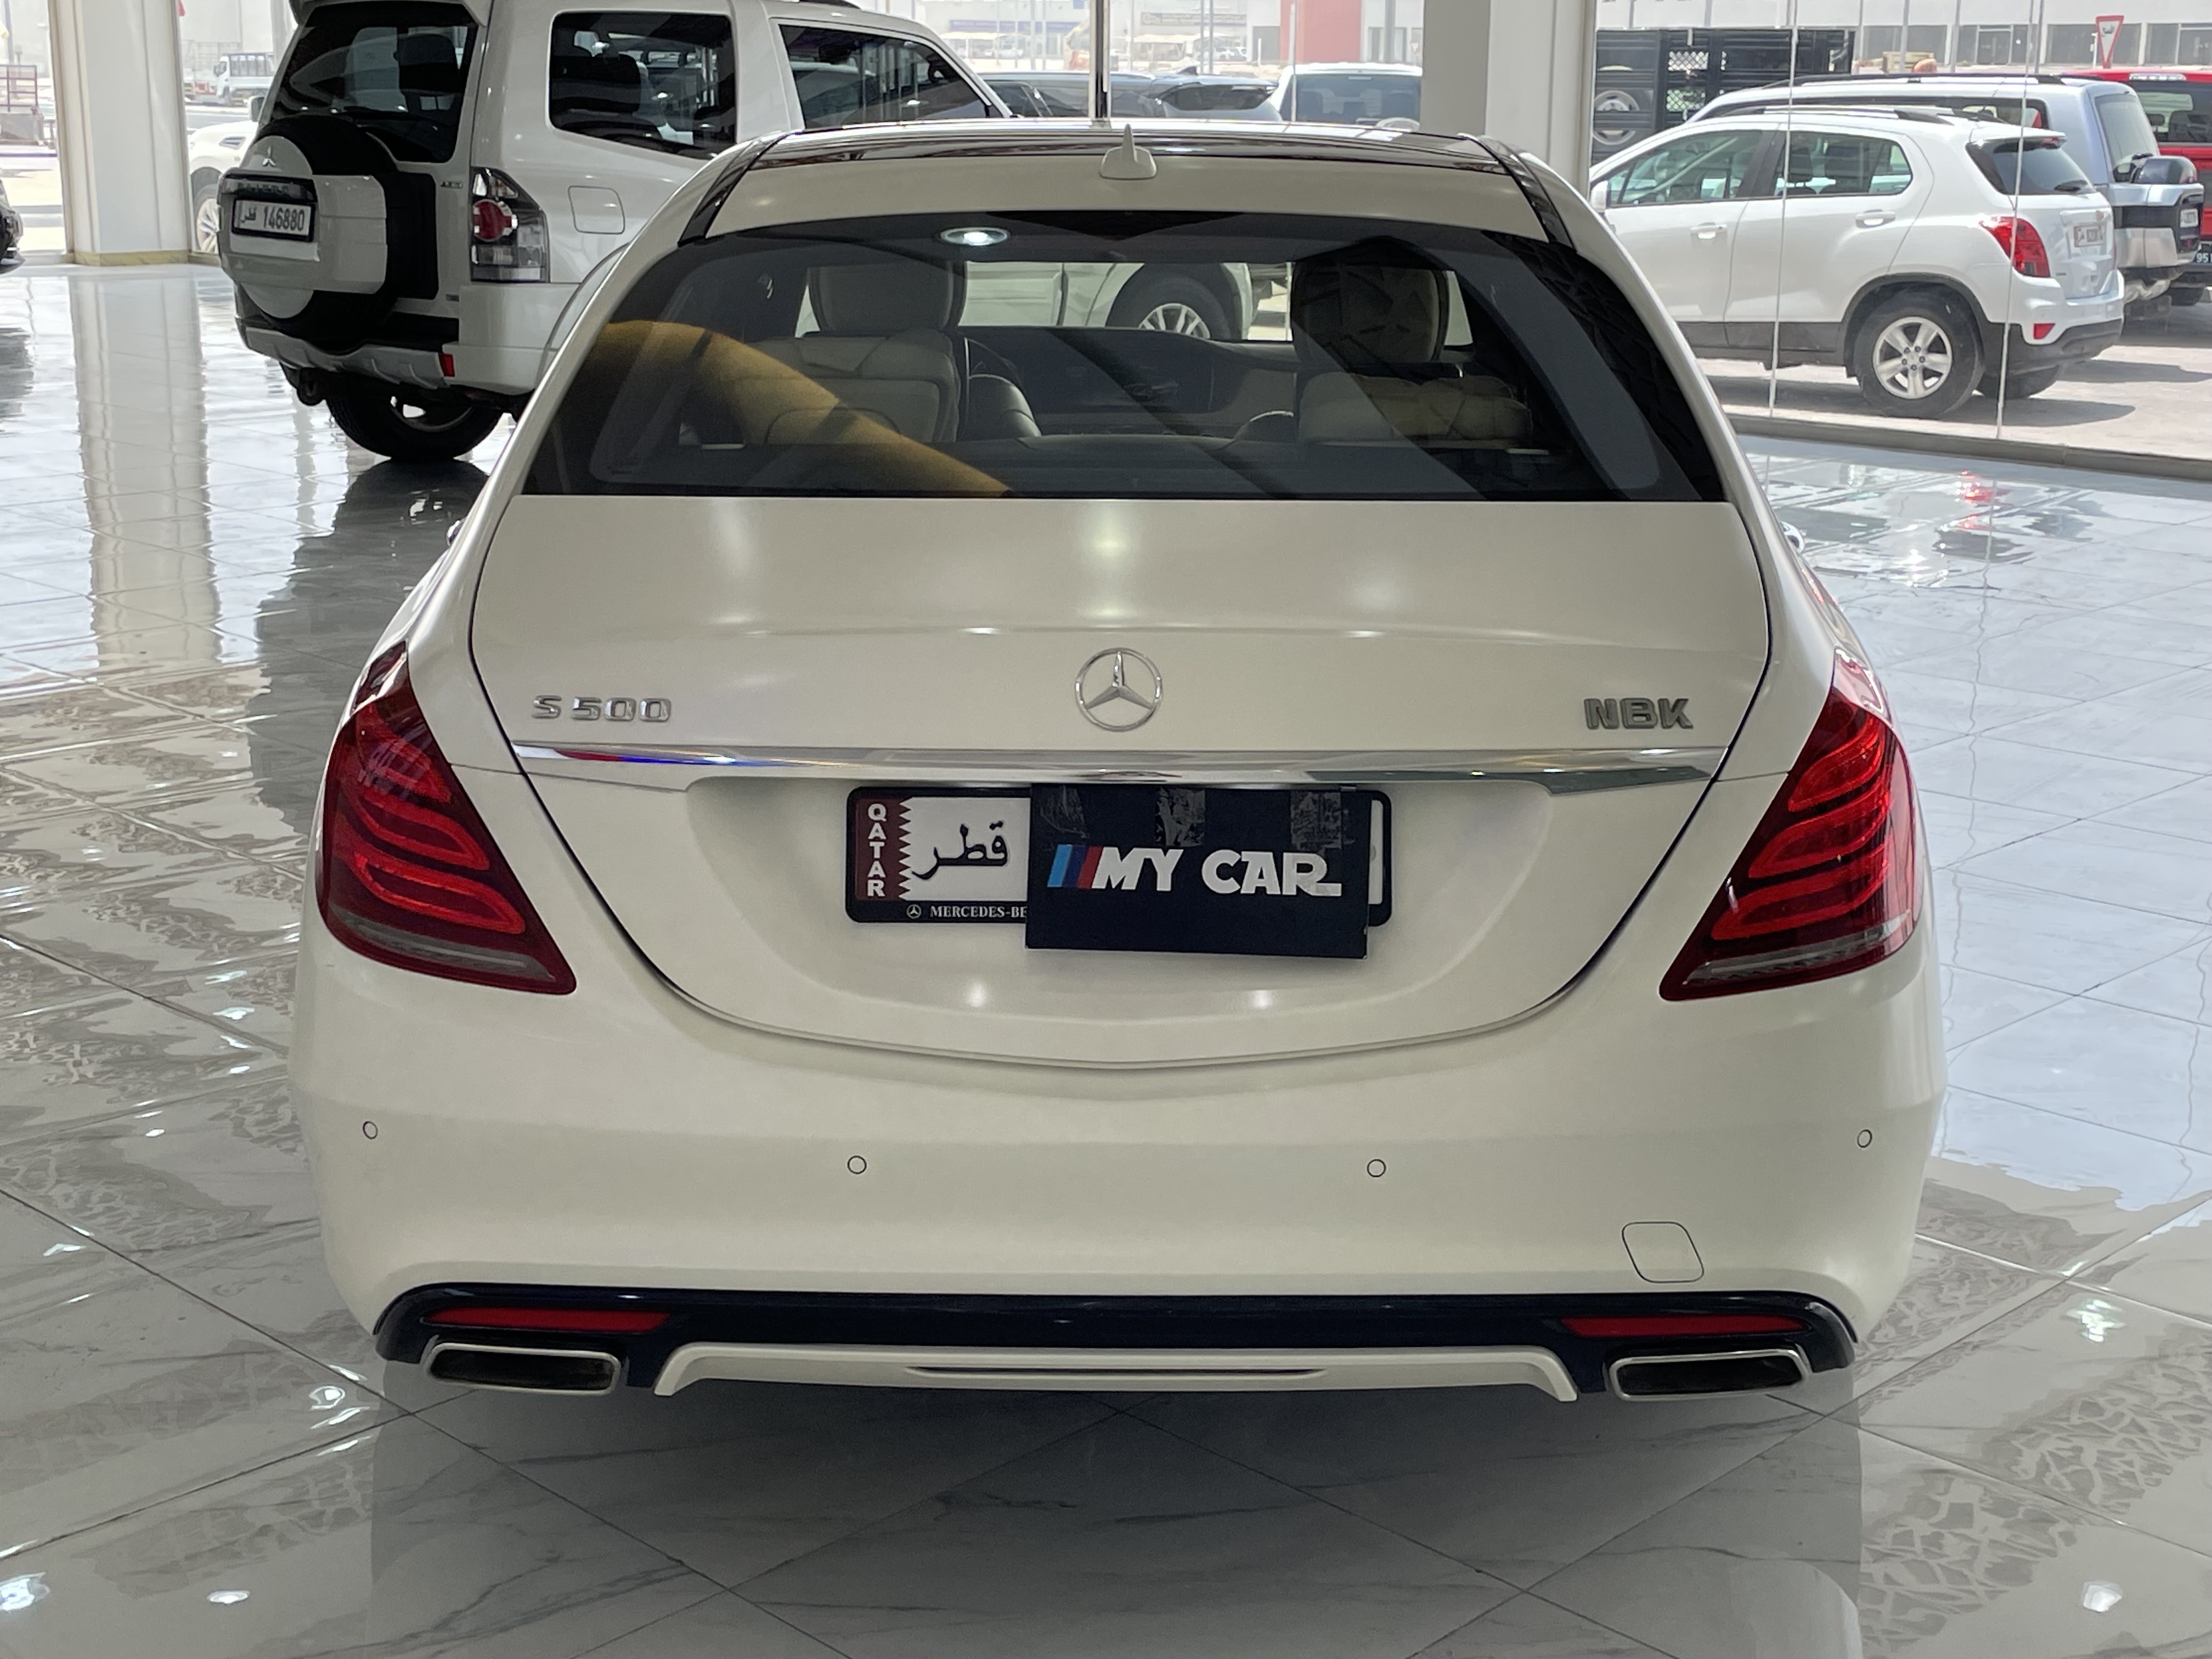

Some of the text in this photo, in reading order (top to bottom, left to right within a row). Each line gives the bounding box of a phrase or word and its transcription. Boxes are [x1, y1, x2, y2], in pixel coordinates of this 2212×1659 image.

[264, 206, 305, 232] 146880
[2197, 252, 2212, 263] 95
[532, 695, 672, 723] S 500
[1584, 697, 1694, 730] NBK
[867, 803, 887, 898] QATAR
[911, 820, 1008, 881] قطر
[1091, 845, 1342, 897] MY CAR
